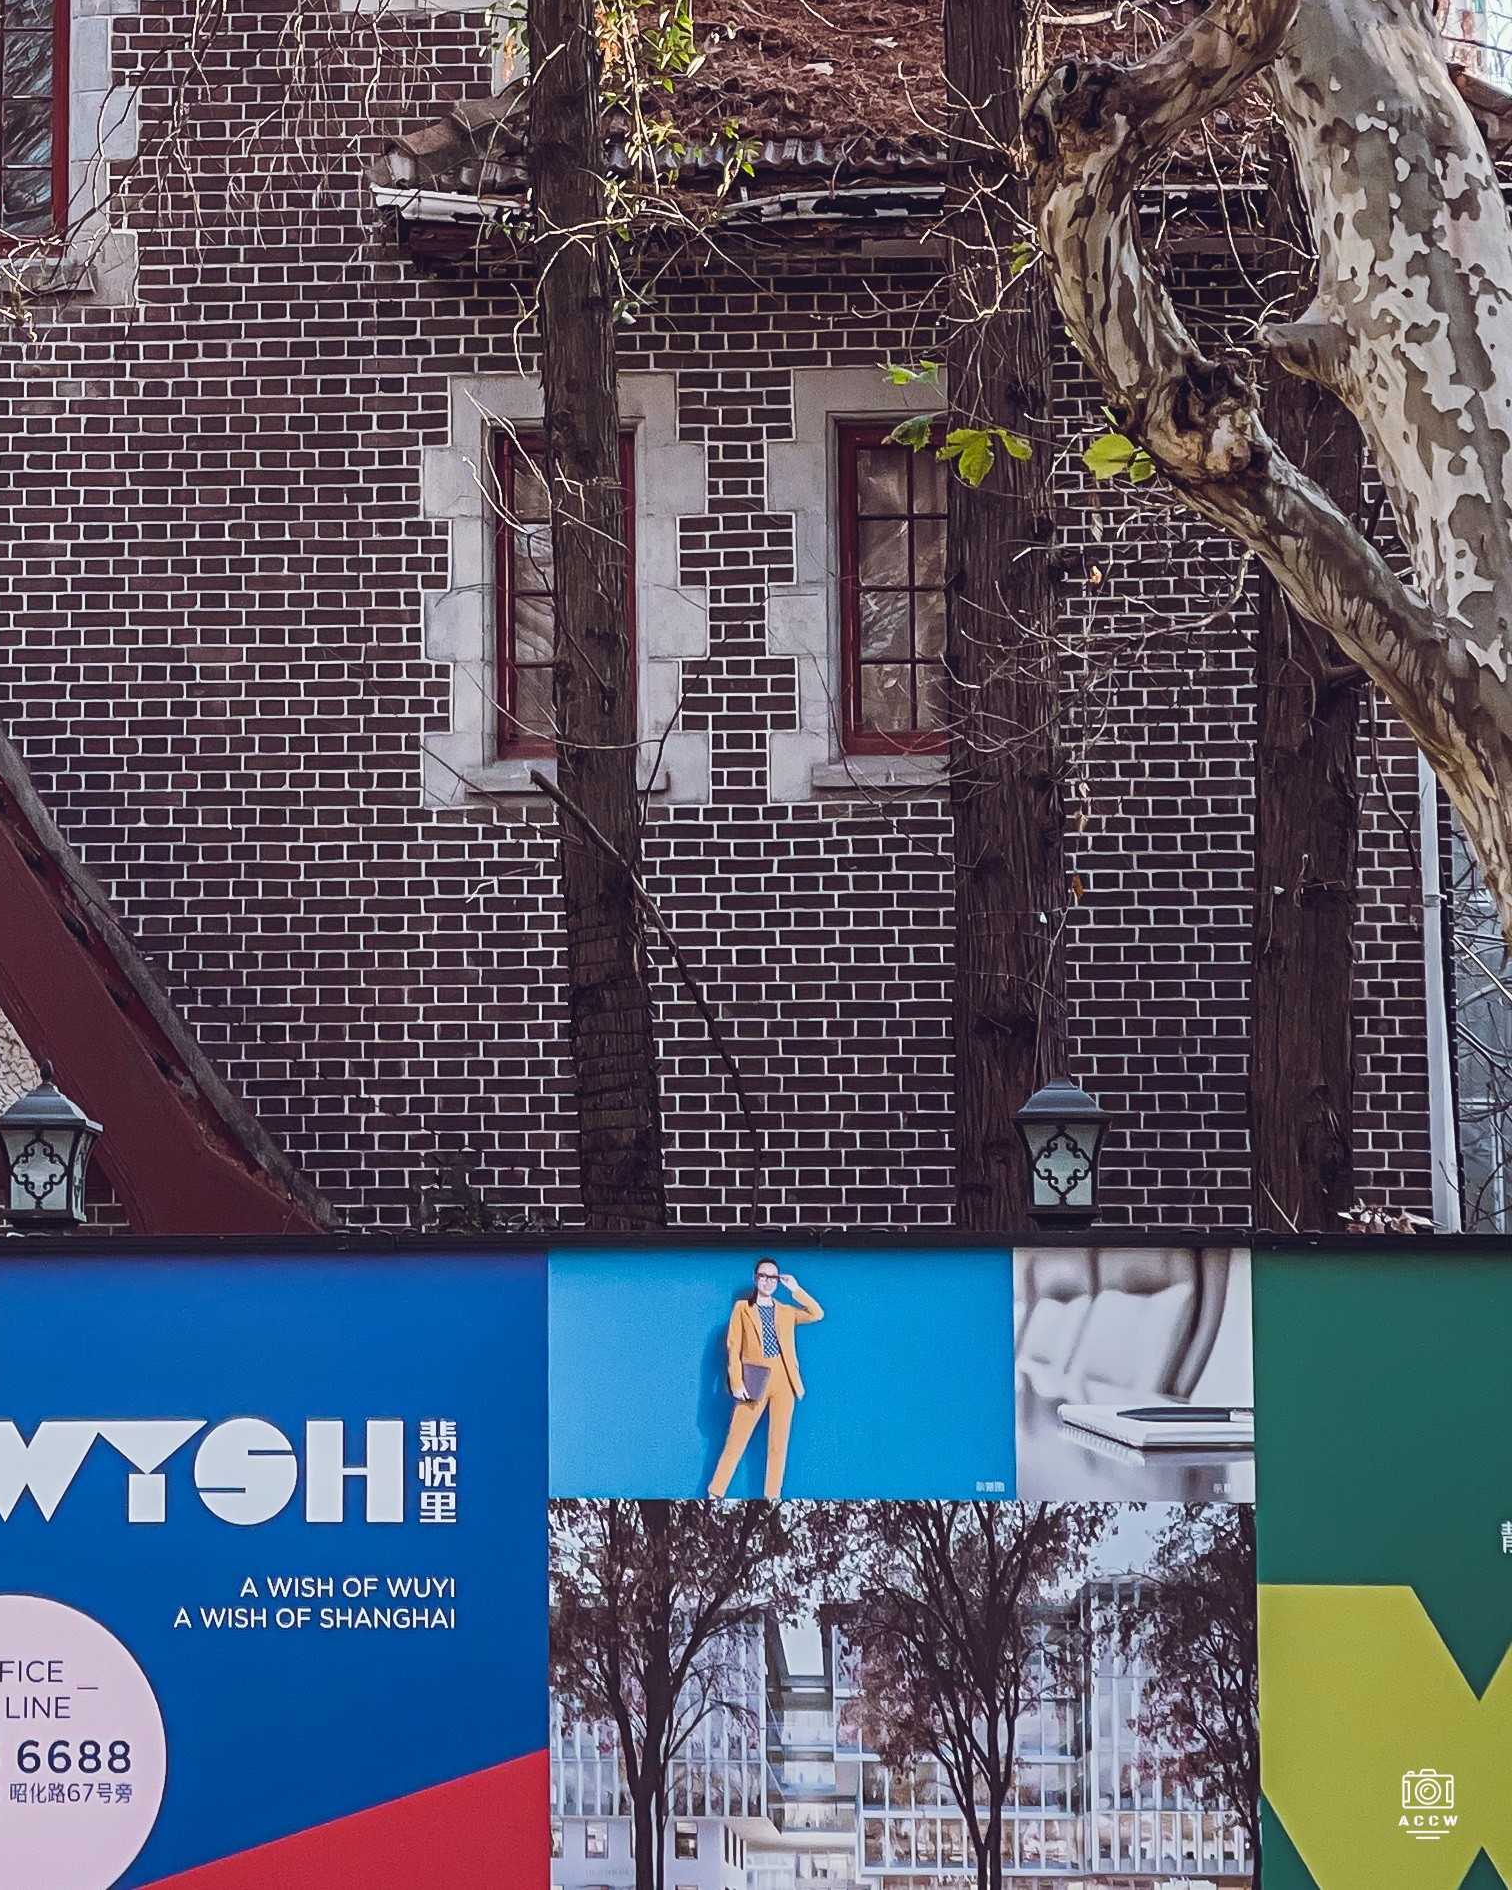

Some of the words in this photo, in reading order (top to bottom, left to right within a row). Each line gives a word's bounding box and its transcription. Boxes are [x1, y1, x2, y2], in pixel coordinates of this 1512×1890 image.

[240, 1576, 259, 1598] A
[266, 1576, 334, 1598] WISH
[342, 1576, 379, 1598] OF
[386, 1576, 455, 1598] WUYI
[173, 1606, 192, 1629] A
[199, 1606, 267, 1629] WISH
[275, 1606, 312, 1629] OF
[319, 1606, 455, 1629] SHANGHAI
[5, 1696, 71, 1719] LINE
[17, 1739, 131, 1774] 6688
